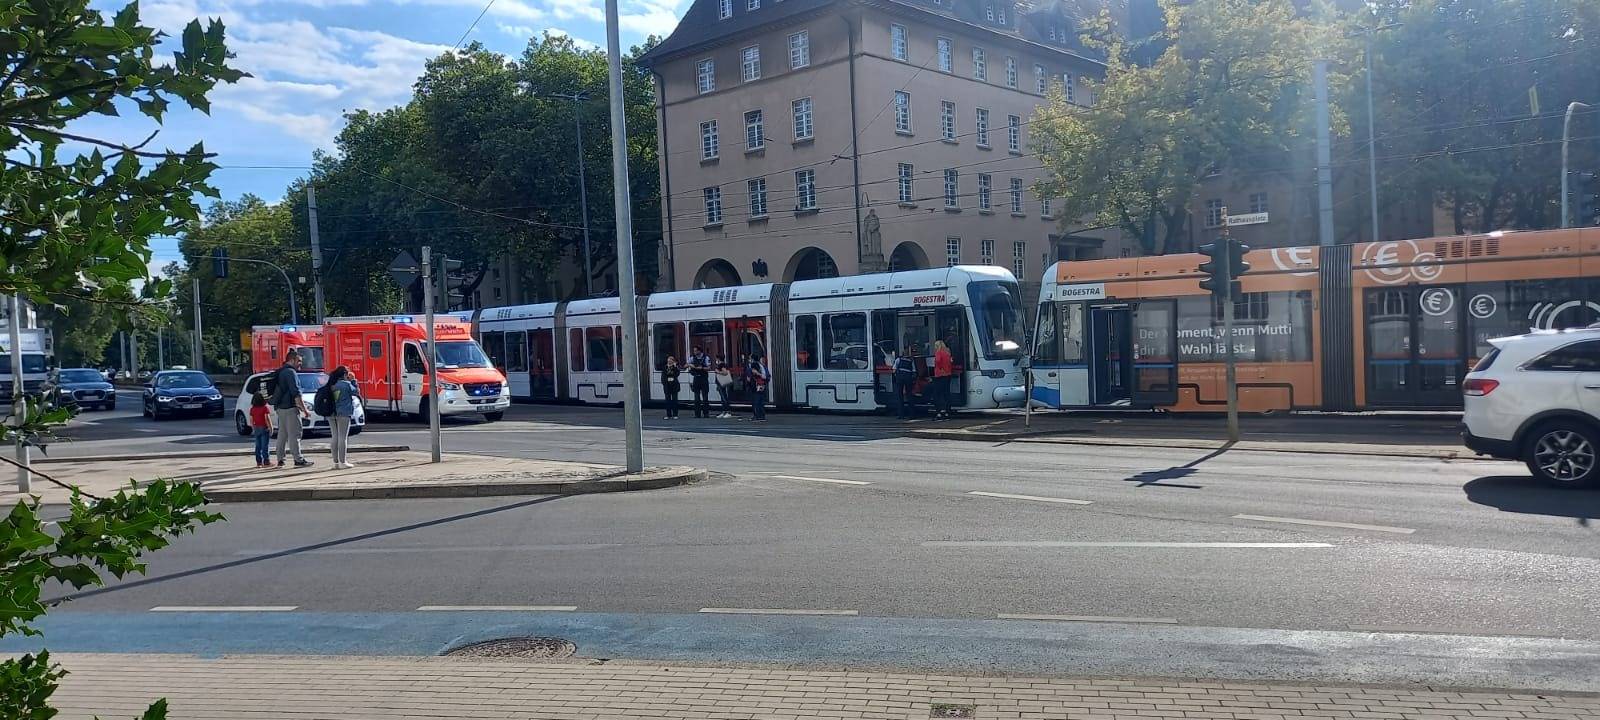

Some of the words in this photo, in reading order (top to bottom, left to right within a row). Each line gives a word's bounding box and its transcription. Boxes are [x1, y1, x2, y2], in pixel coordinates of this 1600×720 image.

[1062, 287, 1100, 297] BOGESTRA
[913, 295, 945, 304] BOGESTRA
[1139, 328, 1158, 339] Der
[1258, 324, 1292, 336] Mutti
[1181, 343, 1212, 355] Wahl
[1216, 343, 1247, 355] läst.
